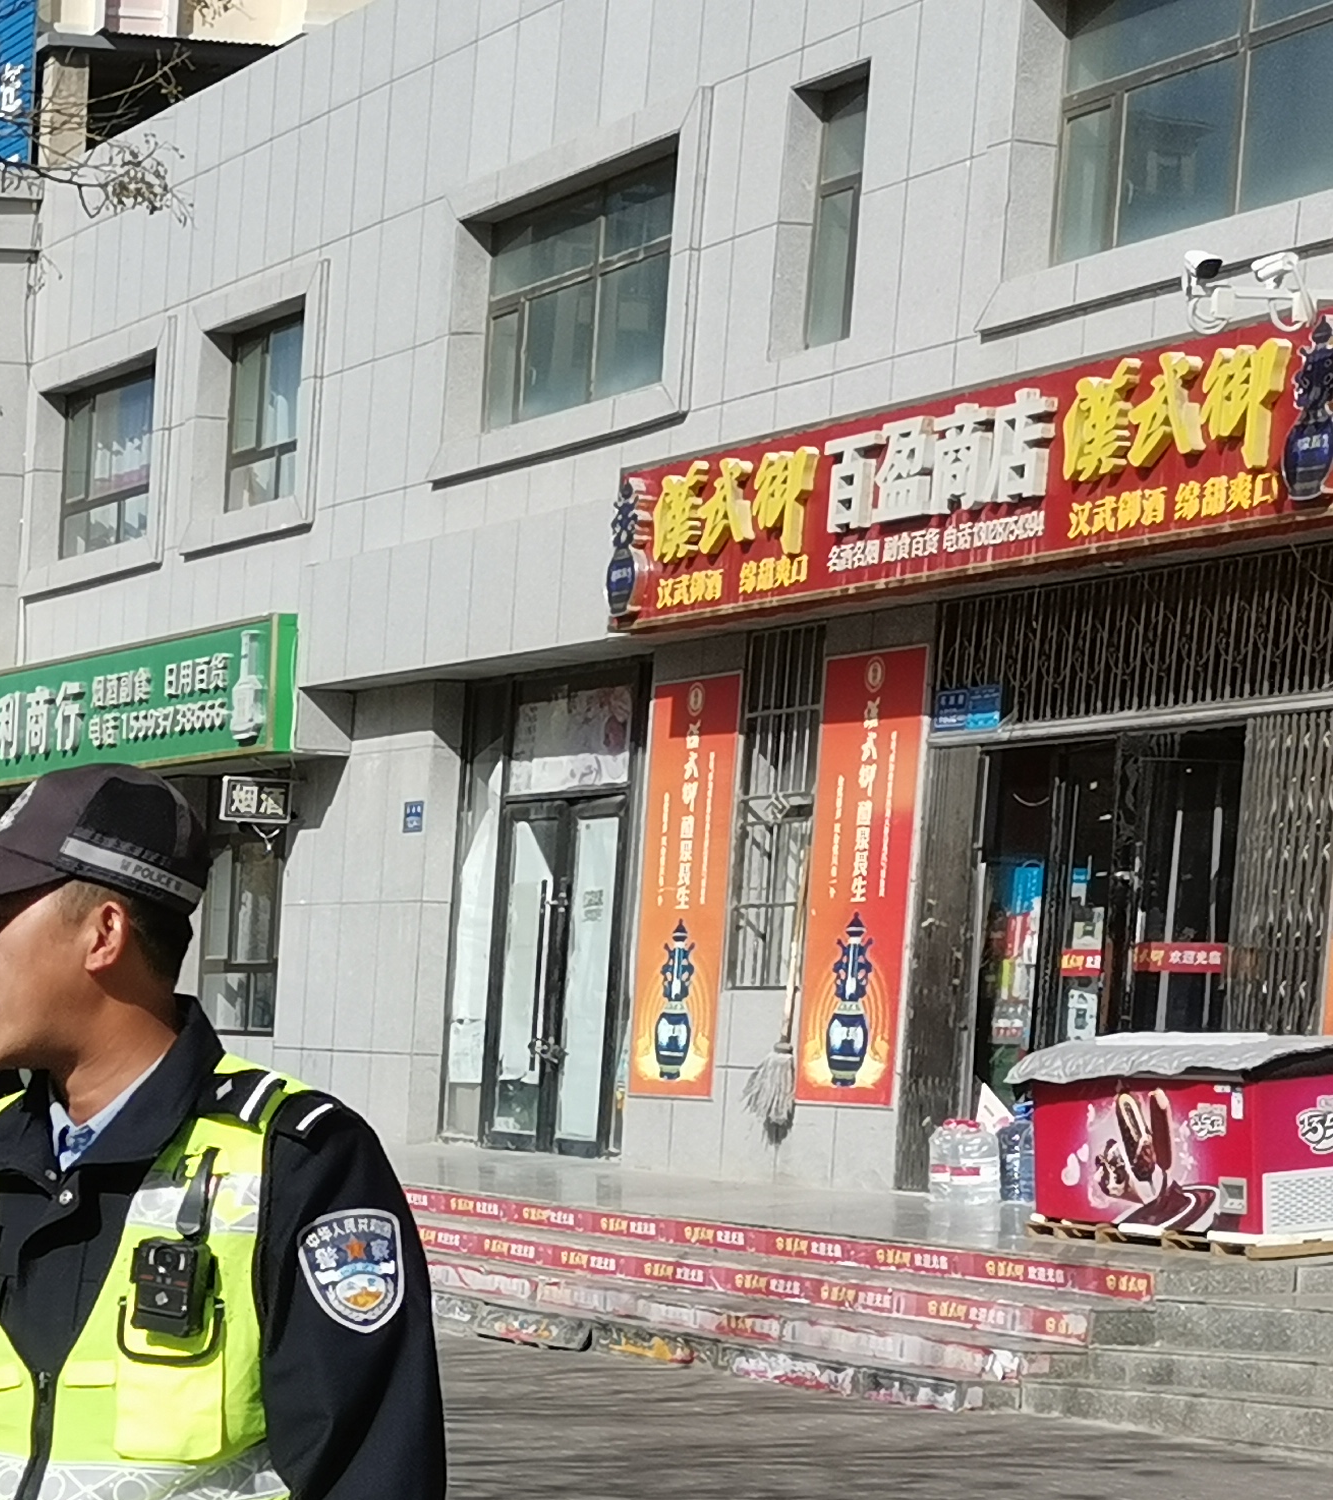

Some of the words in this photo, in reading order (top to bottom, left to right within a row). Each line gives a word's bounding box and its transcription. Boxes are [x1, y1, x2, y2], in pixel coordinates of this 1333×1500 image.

[825, 388, 1058, 533] 百盈商店
[1067, 487, 1168, 539] 汉武御酒
[1174, 472, 1279, 520] 绵甜爽口
[164, 652, 234, 697] 日用百货
[231, 784, 287, 816] 烟酒
[131, 864, 175, 889] POLICE
